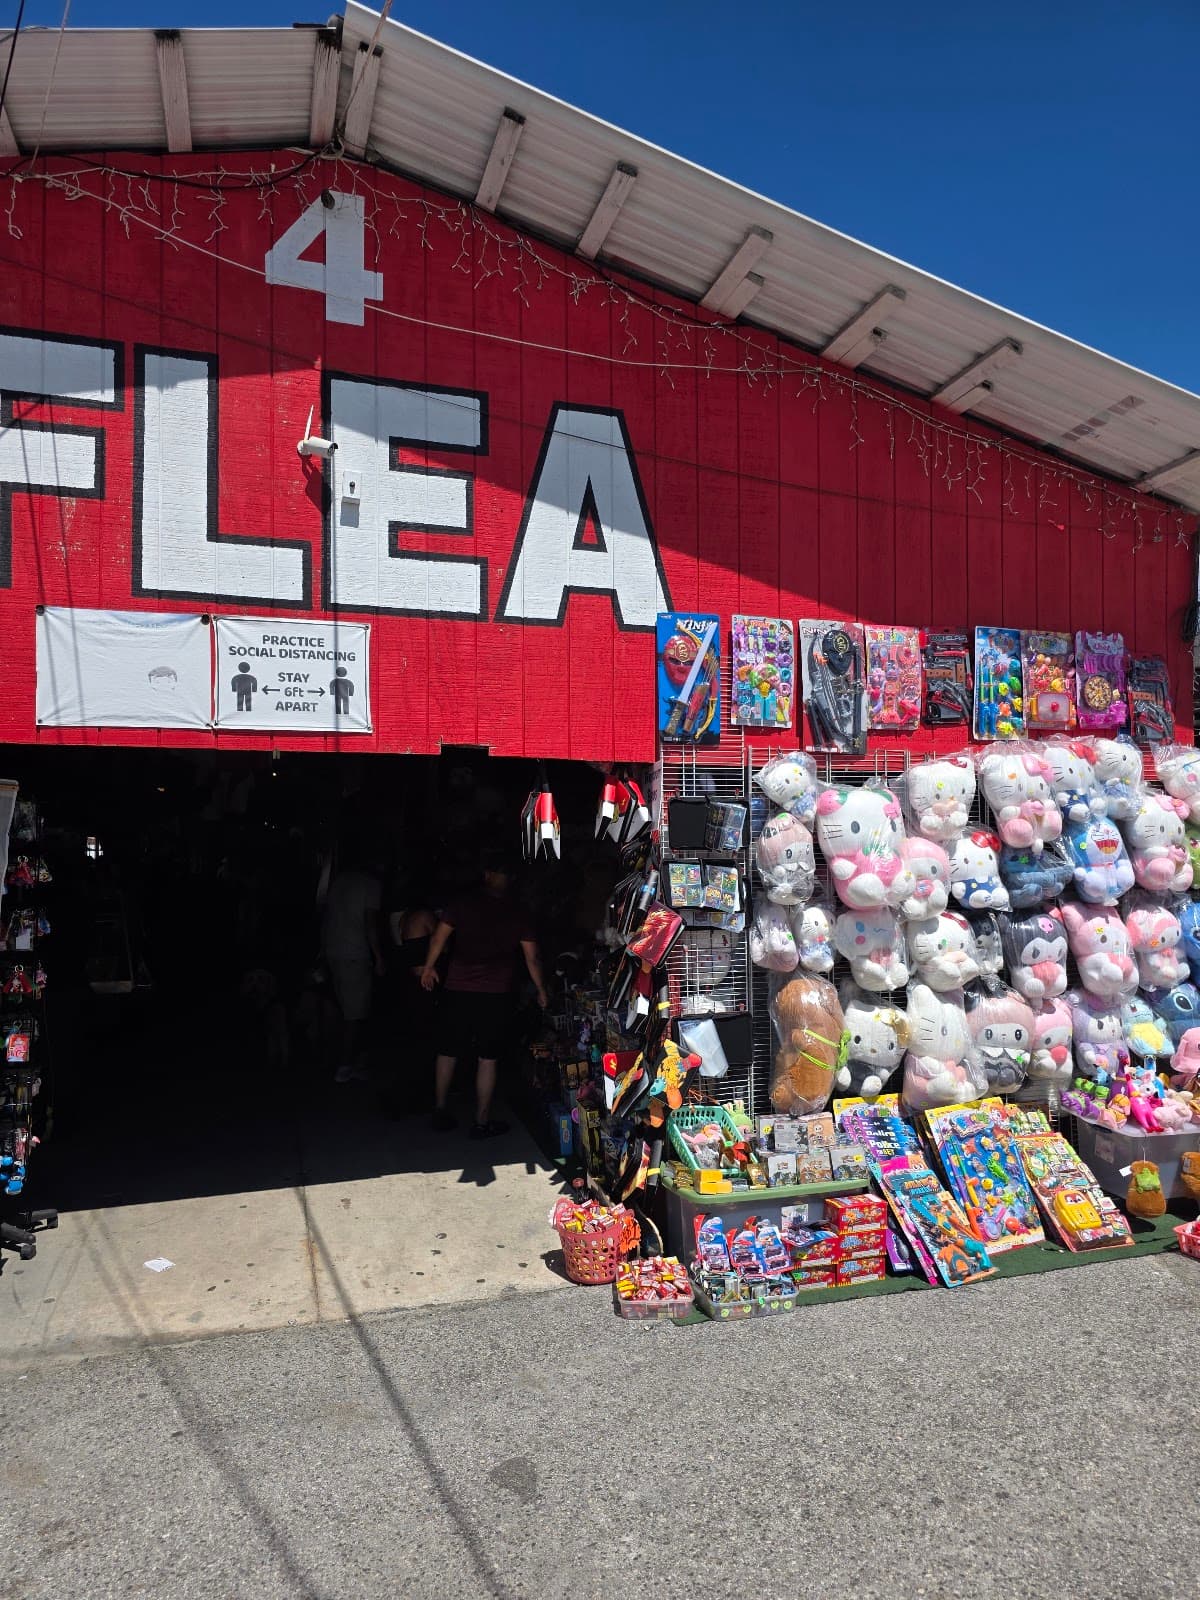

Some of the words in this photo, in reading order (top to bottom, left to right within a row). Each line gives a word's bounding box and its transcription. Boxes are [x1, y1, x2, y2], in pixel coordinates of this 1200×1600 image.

[264, 190, 384, 327] 4
[0, 326, 673, 633] FLEA
[262, 634, 325, 648] PRACTICE
[228, 645, 276, 658] SOCIAL
[278, 648, 356, 661] DISTANCING
[278, 672, 310, 683] STAY
[284, 686, 304, 697] 6ft
[275, 701, 318, 712] APART
